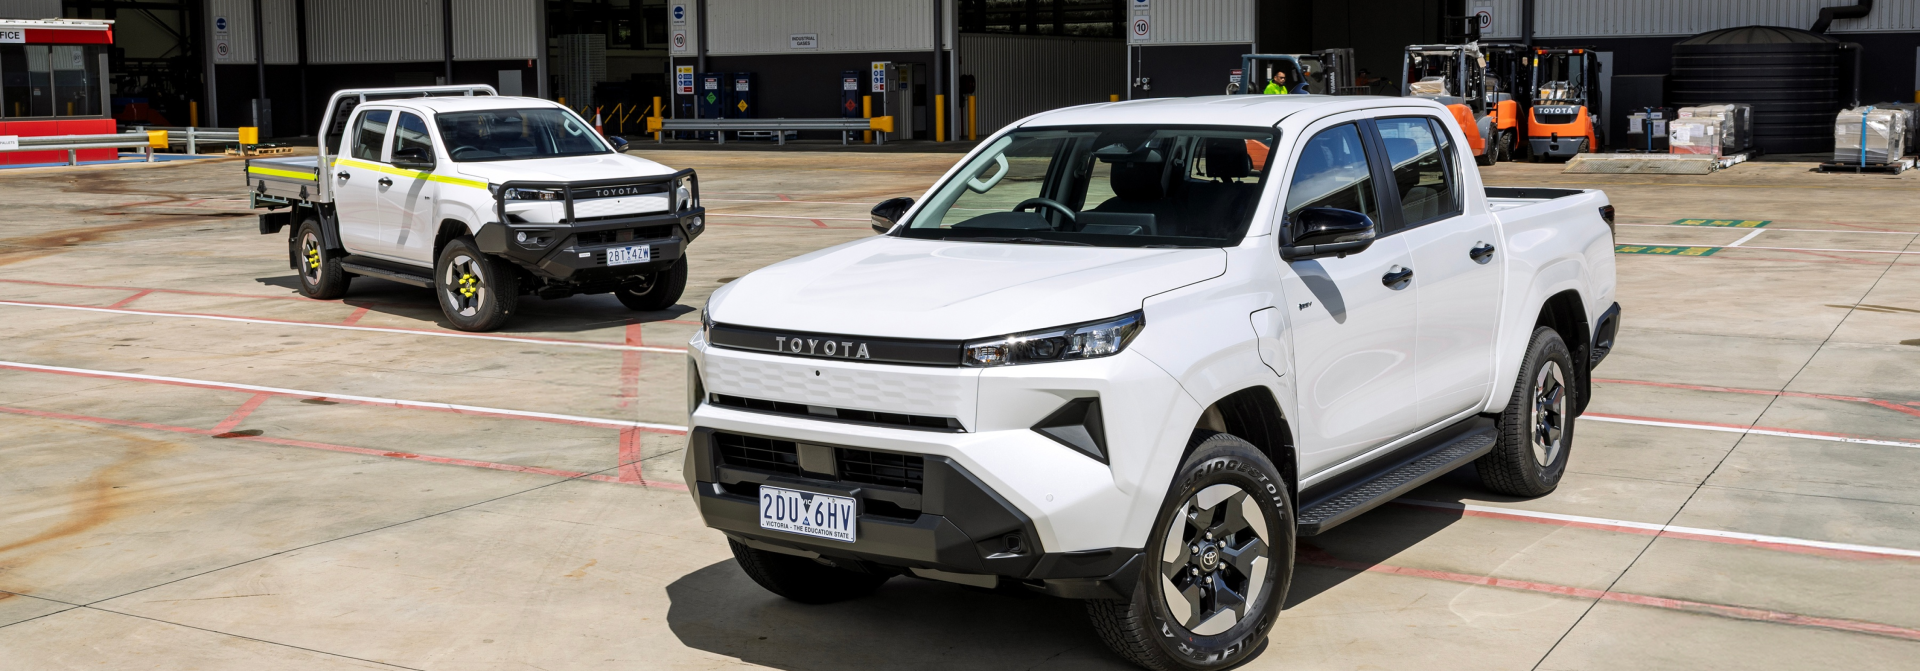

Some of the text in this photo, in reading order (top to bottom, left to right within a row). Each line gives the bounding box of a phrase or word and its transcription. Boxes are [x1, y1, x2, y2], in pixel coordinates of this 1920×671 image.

[1136, 22, 1147, 32] 10
[596, 188, 638, 196] TOYOTA
[609, 250, 625, 262] 2BT
[632, 248, 649, 259] 4ZW
[775, 336, 871, 359] TOYOTA
[764, 493, 798, 522] 2DU
[815, 502, 850, 531] 6HV
[766, 521, 788, 529] VICTORIA
[804, 526, 834, 536] EDUCATION
[834, 531, 850, 539] STATE
